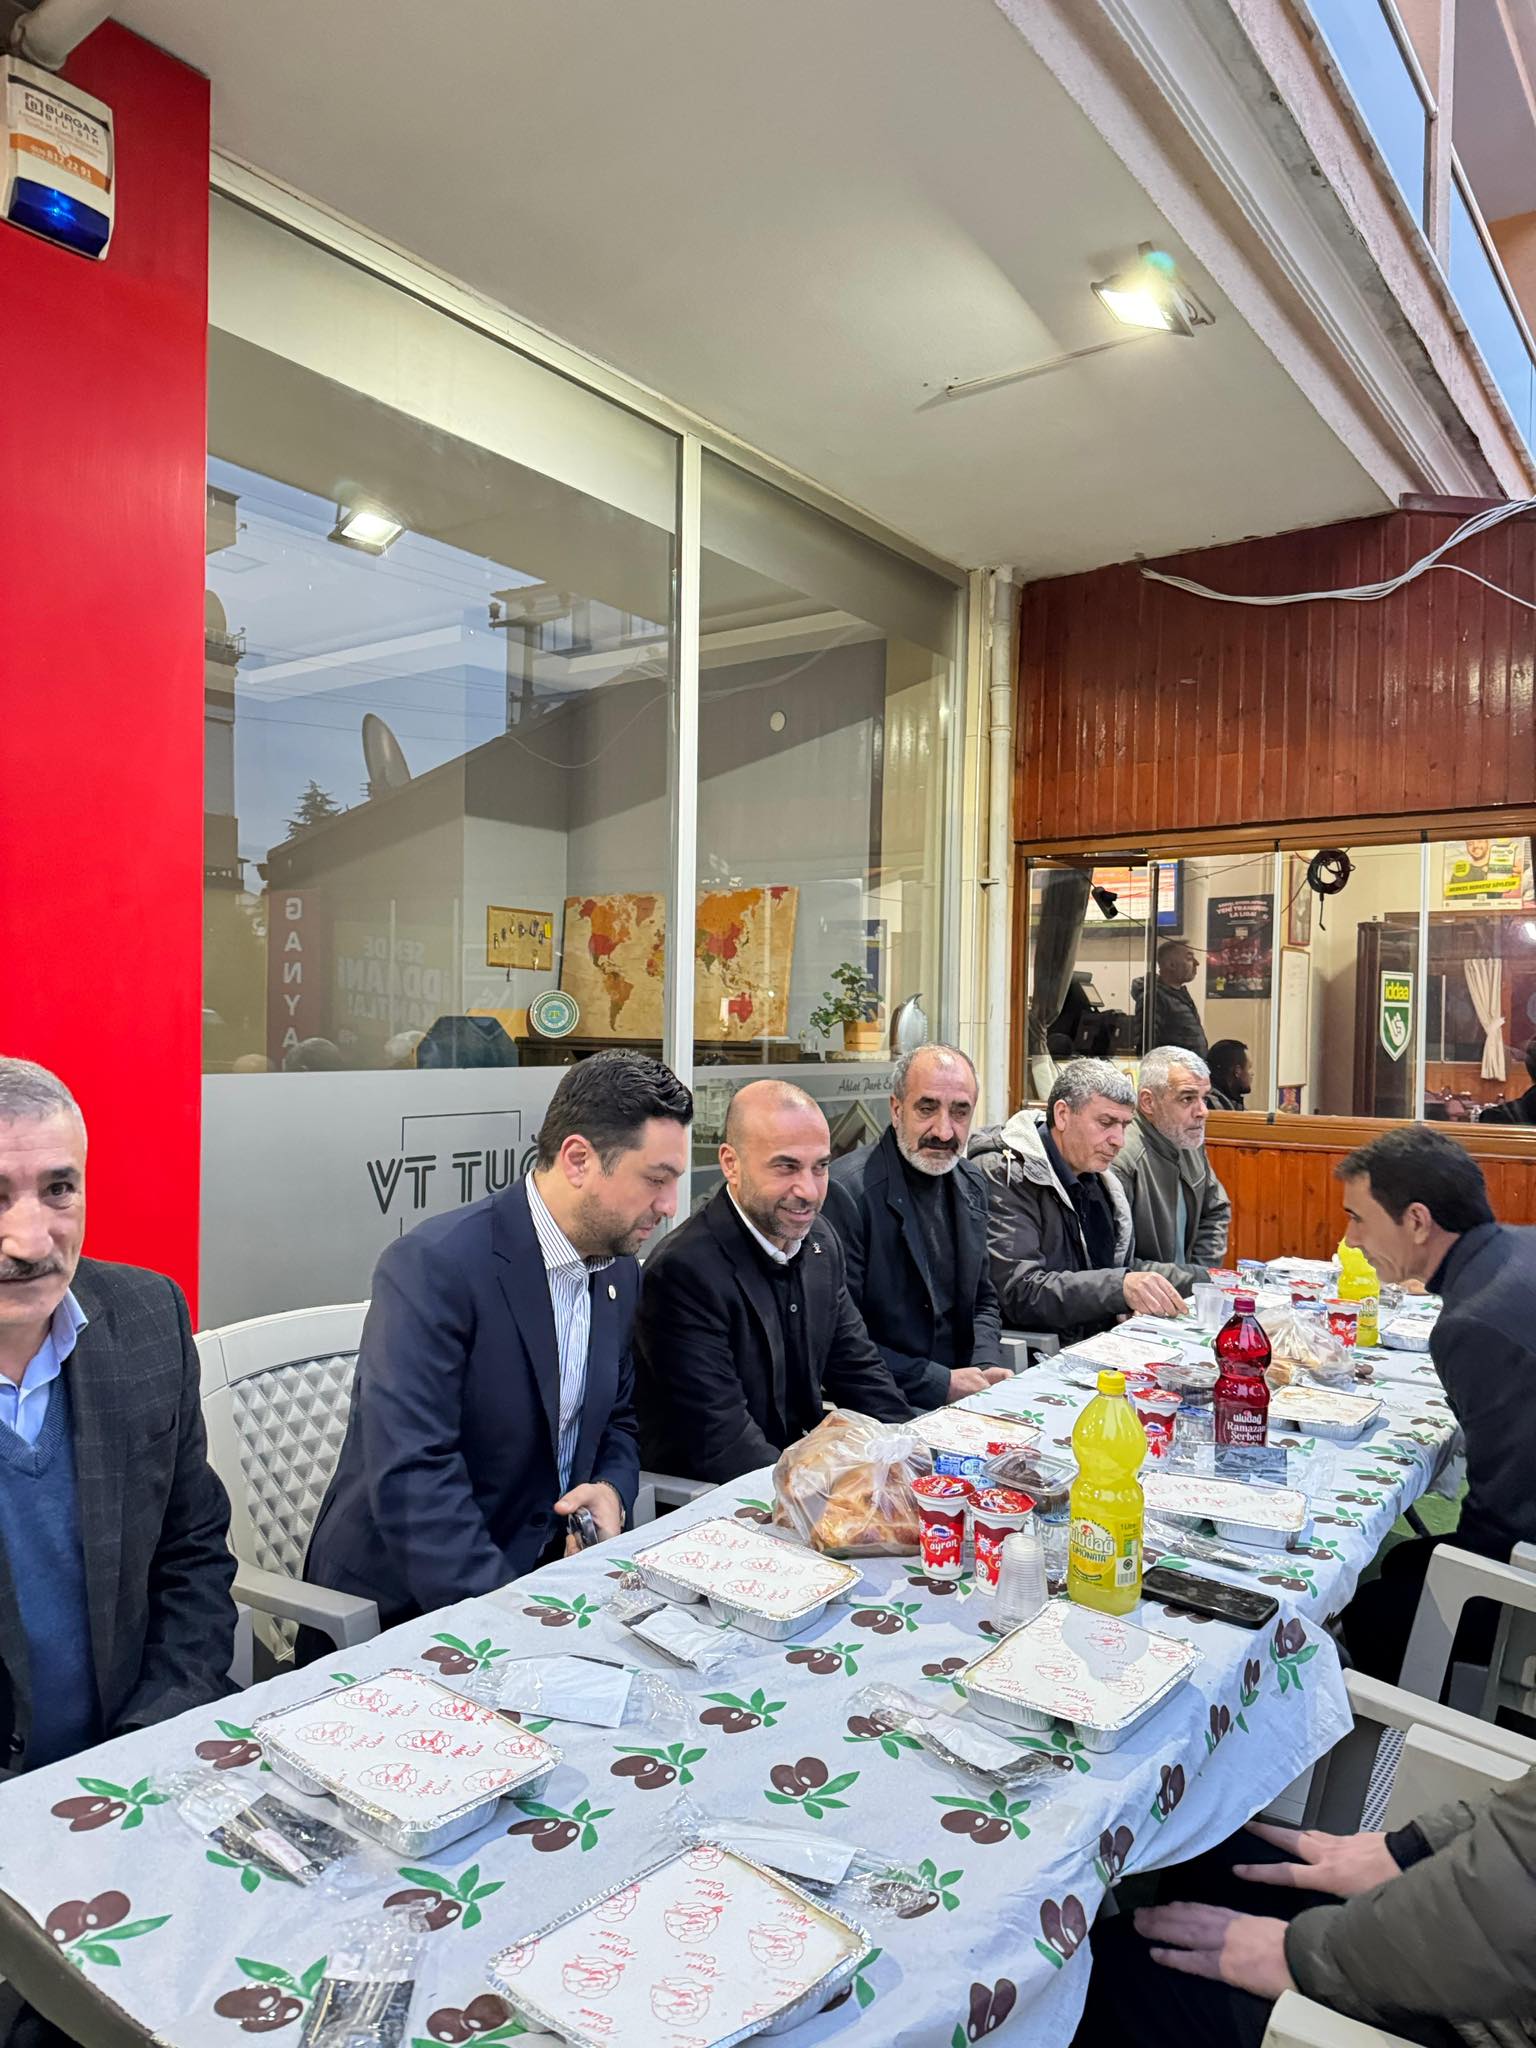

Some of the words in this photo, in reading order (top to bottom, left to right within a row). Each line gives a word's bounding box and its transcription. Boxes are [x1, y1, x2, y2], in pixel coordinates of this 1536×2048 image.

[45, 103, 99, 138] BURGAZ
[1385, 981, 1409, 1000] iddaa
[366, 1155, 437, 1215] VT
[1227, 1421, 1266, 1432] Ramazan
[1233, 1413, 1263, 1425] uludağ
[930, 1539, 958, 1555] ayran
